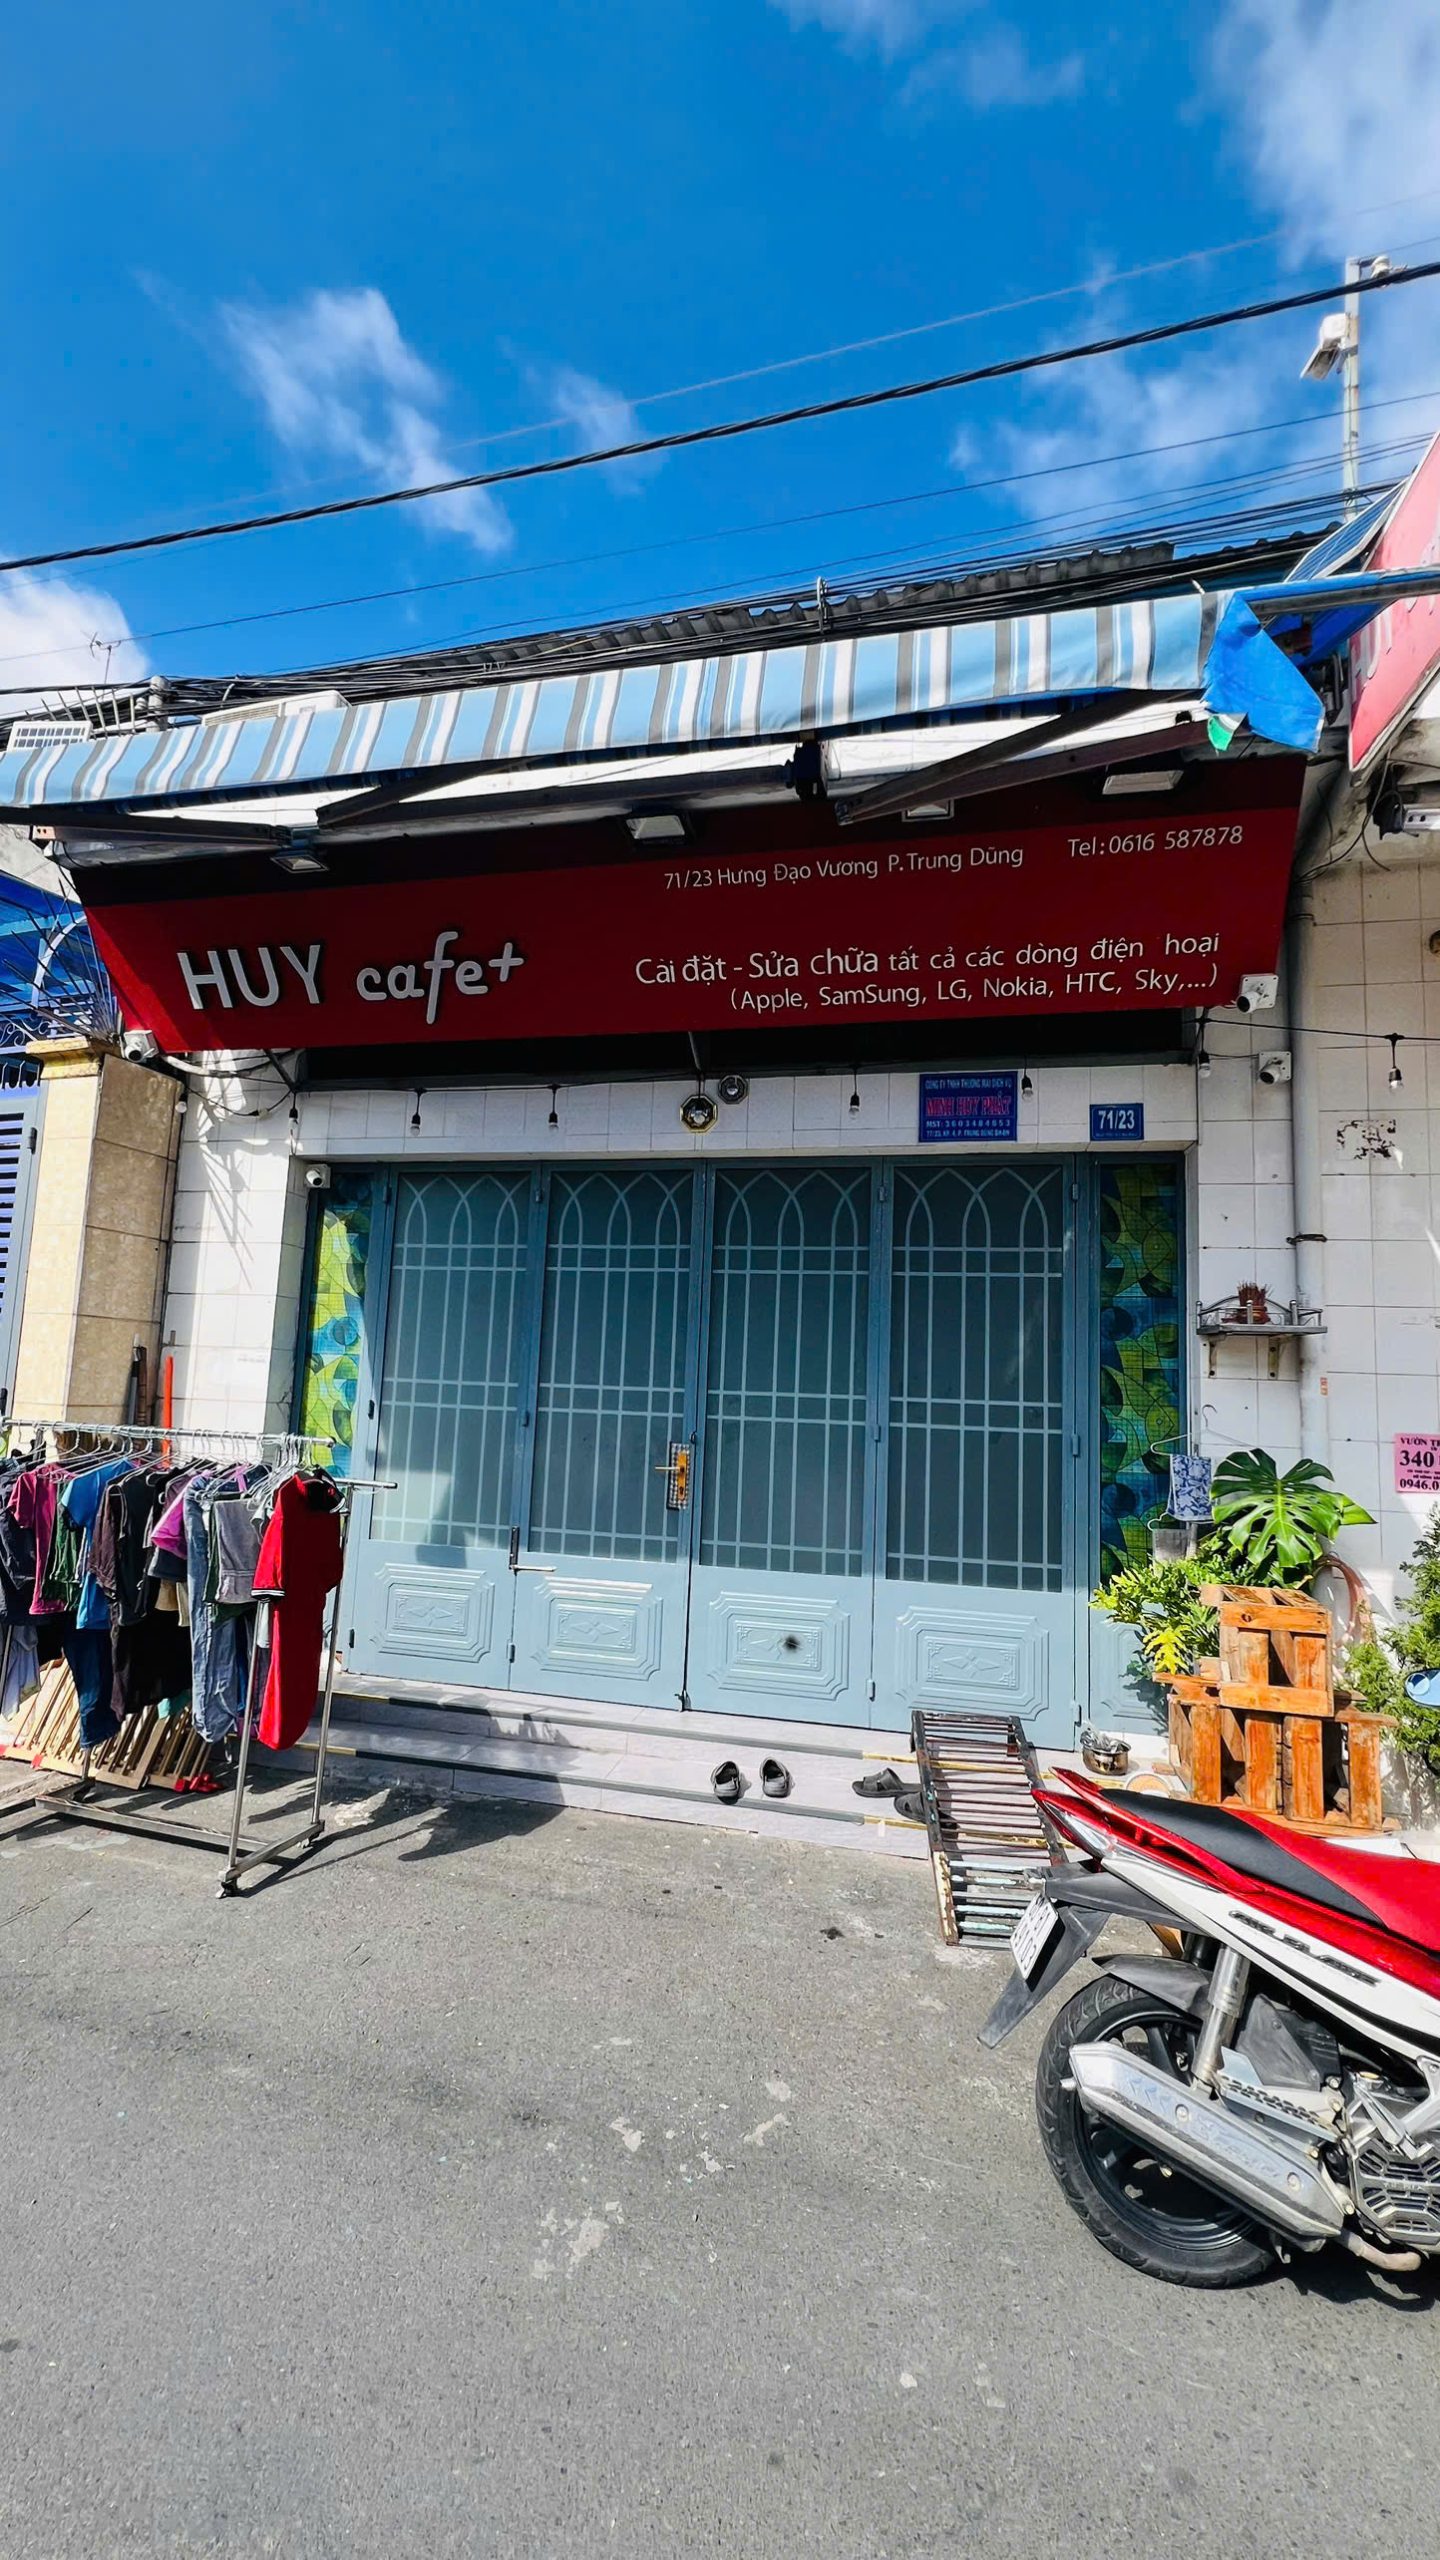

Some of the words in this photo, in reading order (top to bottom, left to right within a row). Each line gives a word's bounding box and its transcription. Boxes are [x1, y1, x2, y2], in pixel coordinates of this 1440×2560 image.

[1164, 825, 1243, 850] 587878
[664, 870, 713, 889] 71/23
[718, 867, 767, 888] Hưng
[774, 863, 811, 884] Đạo
[816, 858, 878, 879] Vương
[970, 846, 1024, 868] Dũng
[635, 957, 676, 985] Cài
[682, 955, 727, 986] đặt
[749, 950, 800, 980] Sửa
[810, 947, 879, 976] chữa
[889, 945, 920, 972] tất
[929, 945, 956, 970] cả
[965, 945, 1005, 968] các
[1015, 942, 1078, 968] dòng
[1090, 937, 1144, 963] điện
[1165, 933, 1220, 958] hoại
[176, 944, 321, 1010] HUY
[356, 931, 524, 1024] cafe+
[730, 987, 809, 1014] (Apple,
[819, 984, 928, 1008] SamSung,
[937, 979, 973, 1001] LG,
[984, 975, 1055, 998] Nokia,
[1065, 971, 1123, 995] HTC,
[926, 1096, 955, 1117] MINH
[956, 1096, 980, 1116] HUY
[1098, 1110, 1135, 1129] 71/23
[1399, 1450, 1435, 1468] 340
